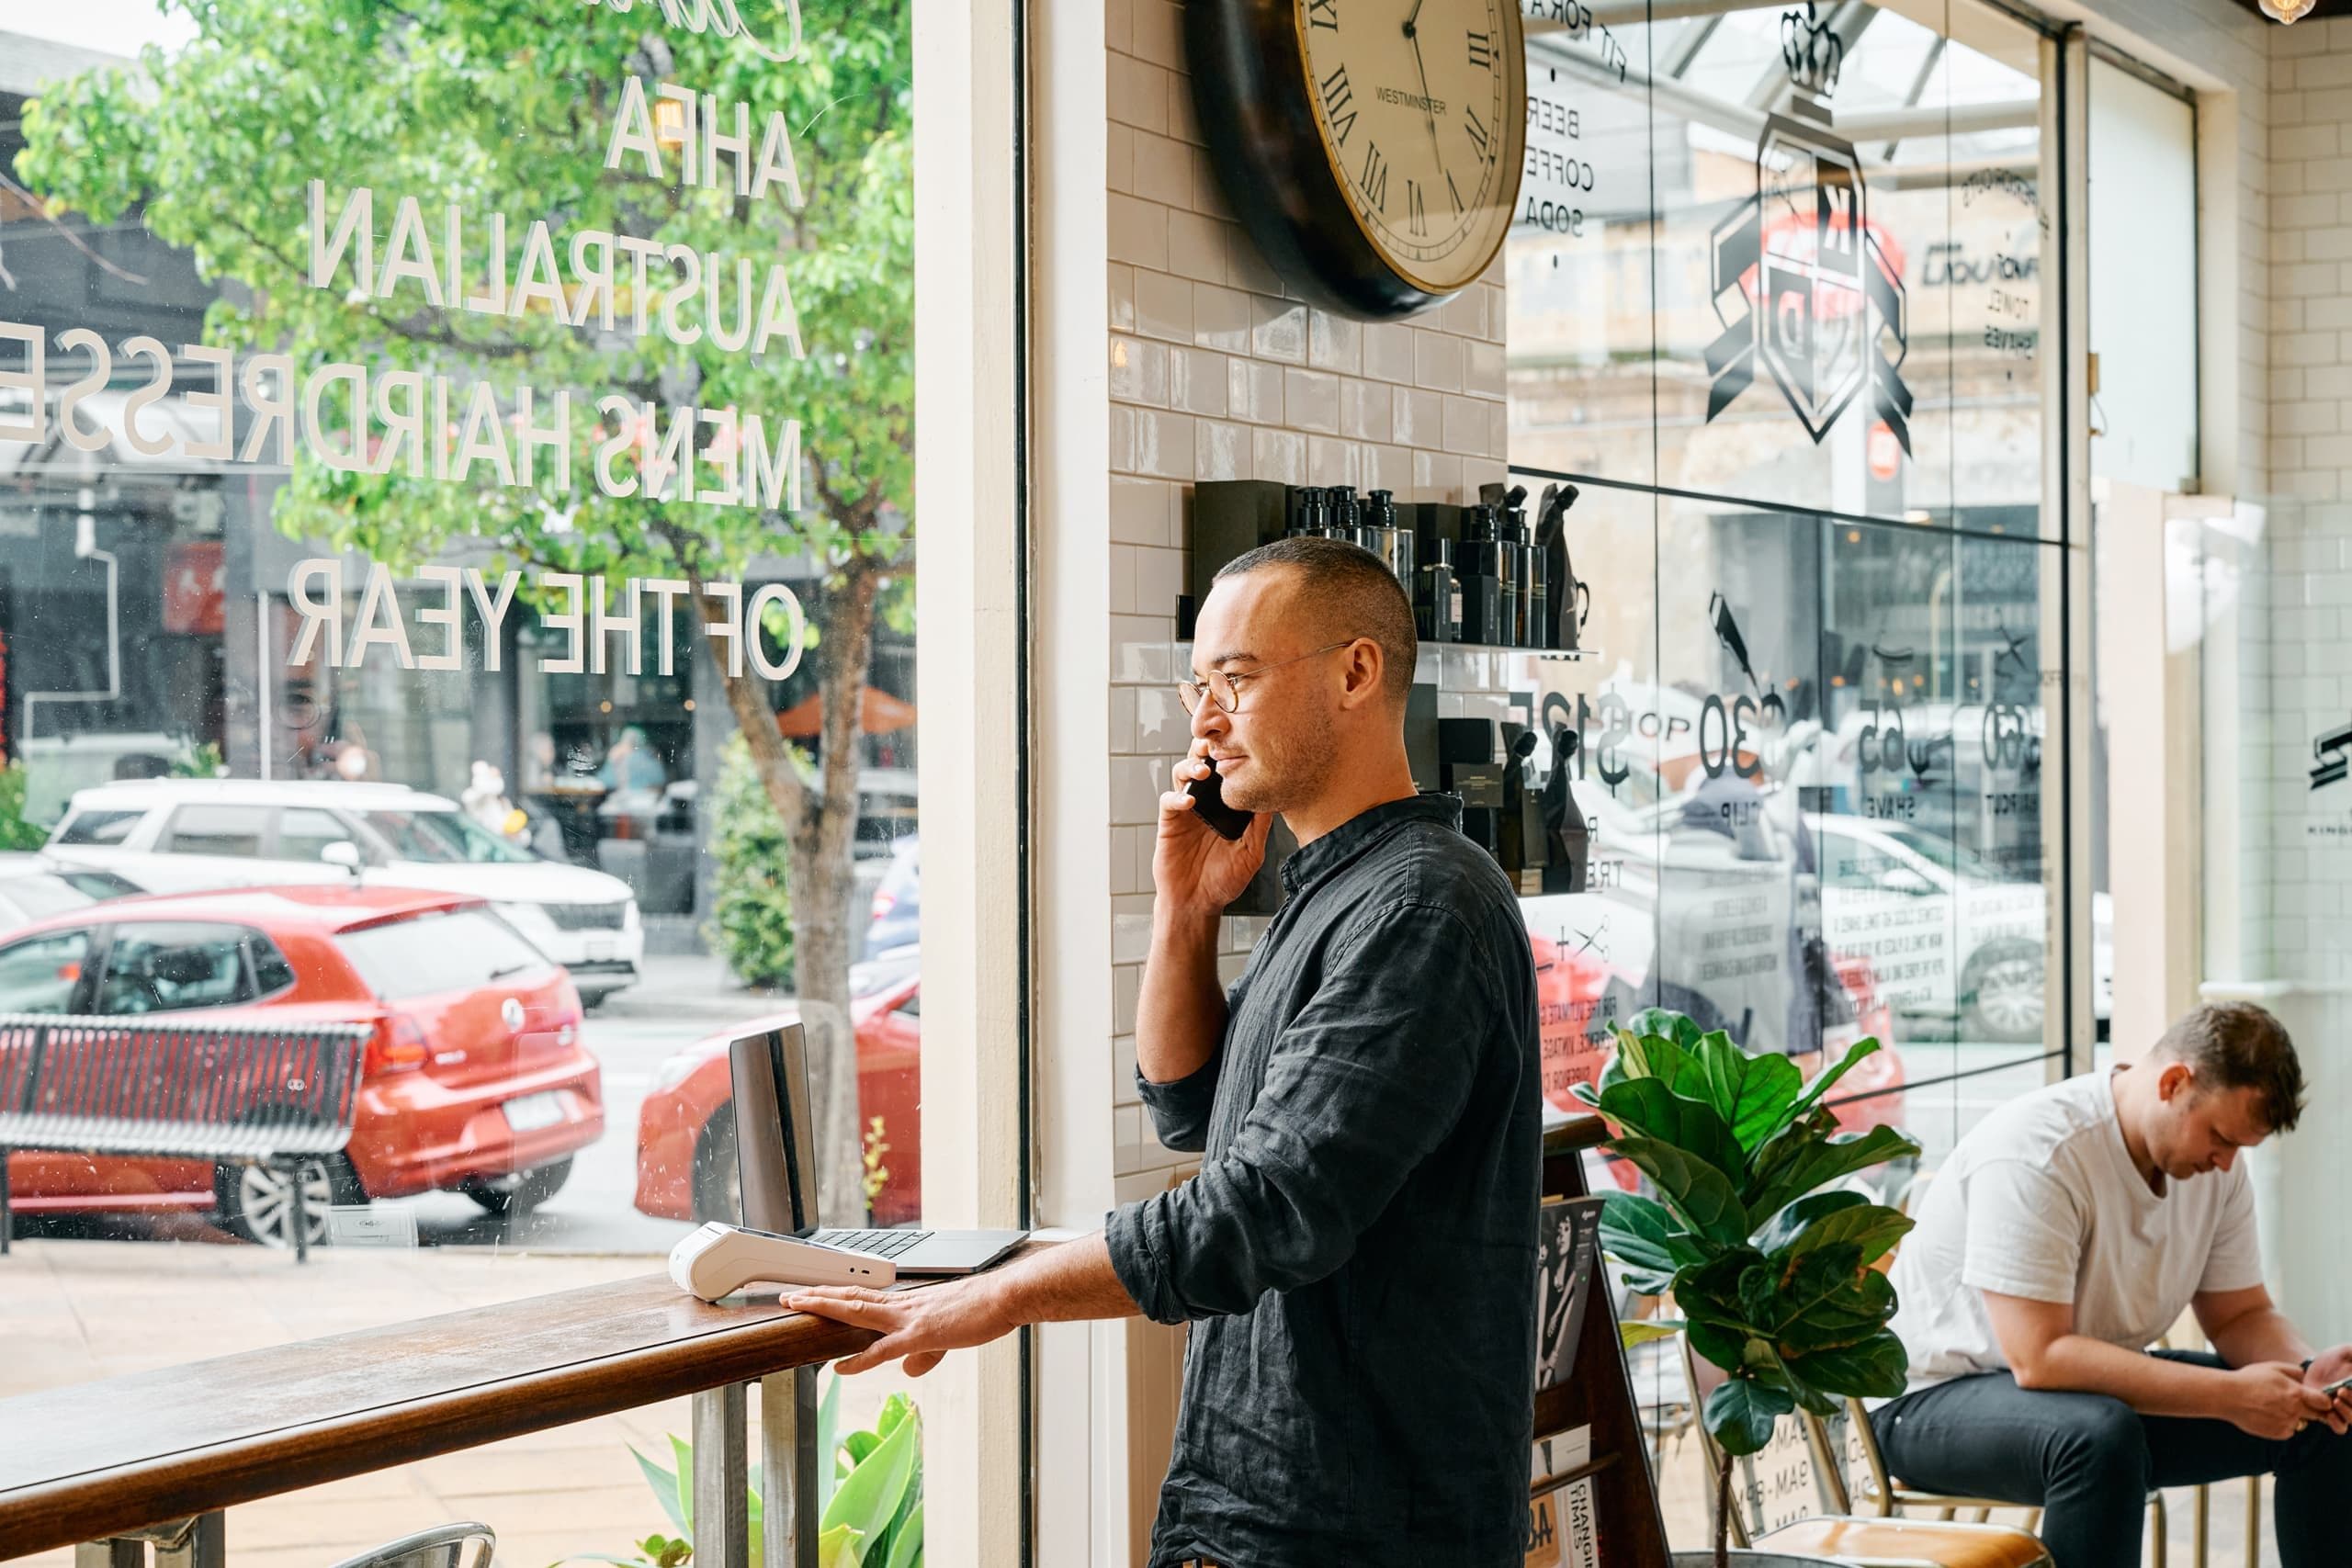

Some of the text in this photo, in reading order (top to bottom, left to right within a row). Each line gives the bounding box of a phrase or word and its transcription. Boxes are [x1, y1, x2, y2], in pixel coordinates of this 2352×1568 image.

[1467, 29, 1491, 72] III
[1321, 62, 1358, 148] VIII
[1375, 86, 1448, 116] WESTMINSTER
[1360, 141, 1388, 214] VII
[1446, 169, 1464, 220] V
[1407, 180, 1428, 237] VI
[1570, 1486, 1583, 1551] TIMES
